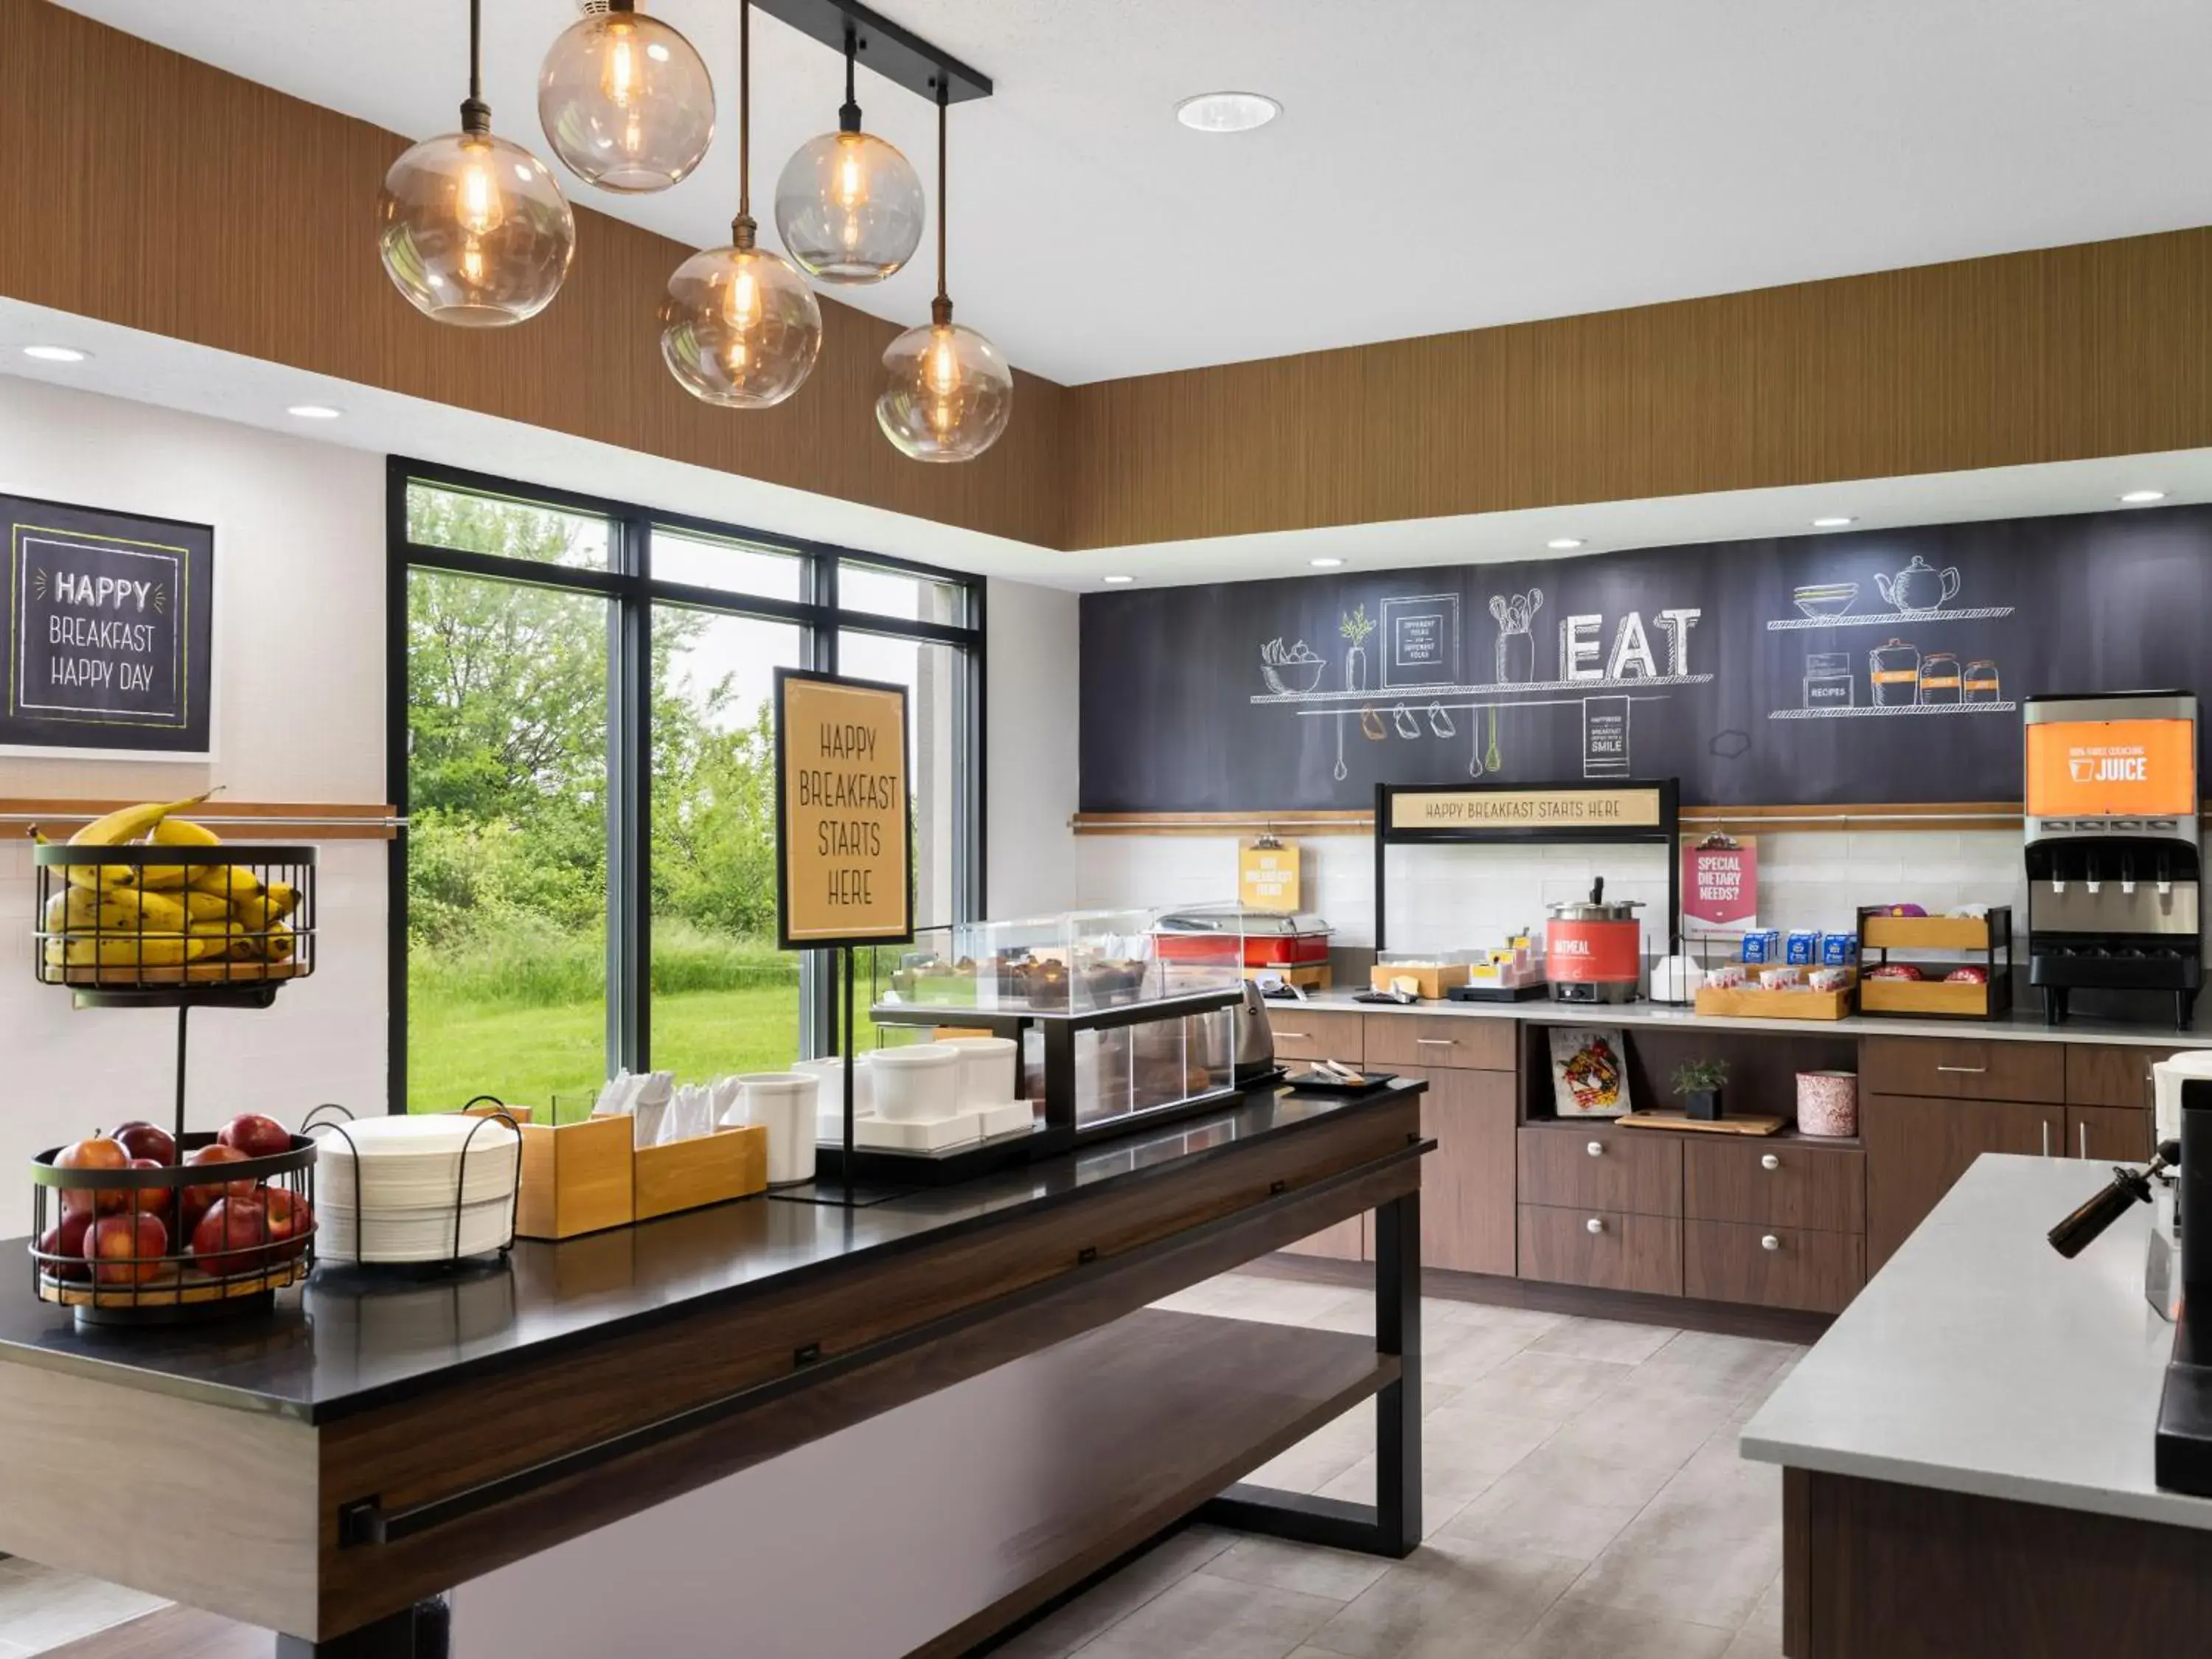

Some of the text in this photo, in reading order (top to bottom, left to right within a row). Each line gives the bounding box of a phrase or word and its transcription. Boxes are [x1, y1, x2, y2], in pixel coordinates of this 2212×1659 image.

[55, 571, 151, 613] HAPPY
[49, 614, 156, 653] BREAKFAST
[1559, 608, 1702, 681] EAT
[51, 655, 154, 692] HAPPY DAY
[1810, 686, 1846, 698] RECIPES
[820, 723, 877, 762] HAPPY
[1591, 740, 1623, 753] SMILE
[2095, 757, 2148, 782] JUICE
[799, 769, 897, 810] BREAKFAST
[1425, 799, 1621, 820] HAPPY BREAKFAST STARTS HERE
[818, 820, 881, 857] STARTS
[1698, 856, 1740, 871] SPECIAL
[1698, 871, 1742, 886] DIETARY
[827, 869, 873, 905] HERE
[1700, 886, 1739, 901] NEEDS?
